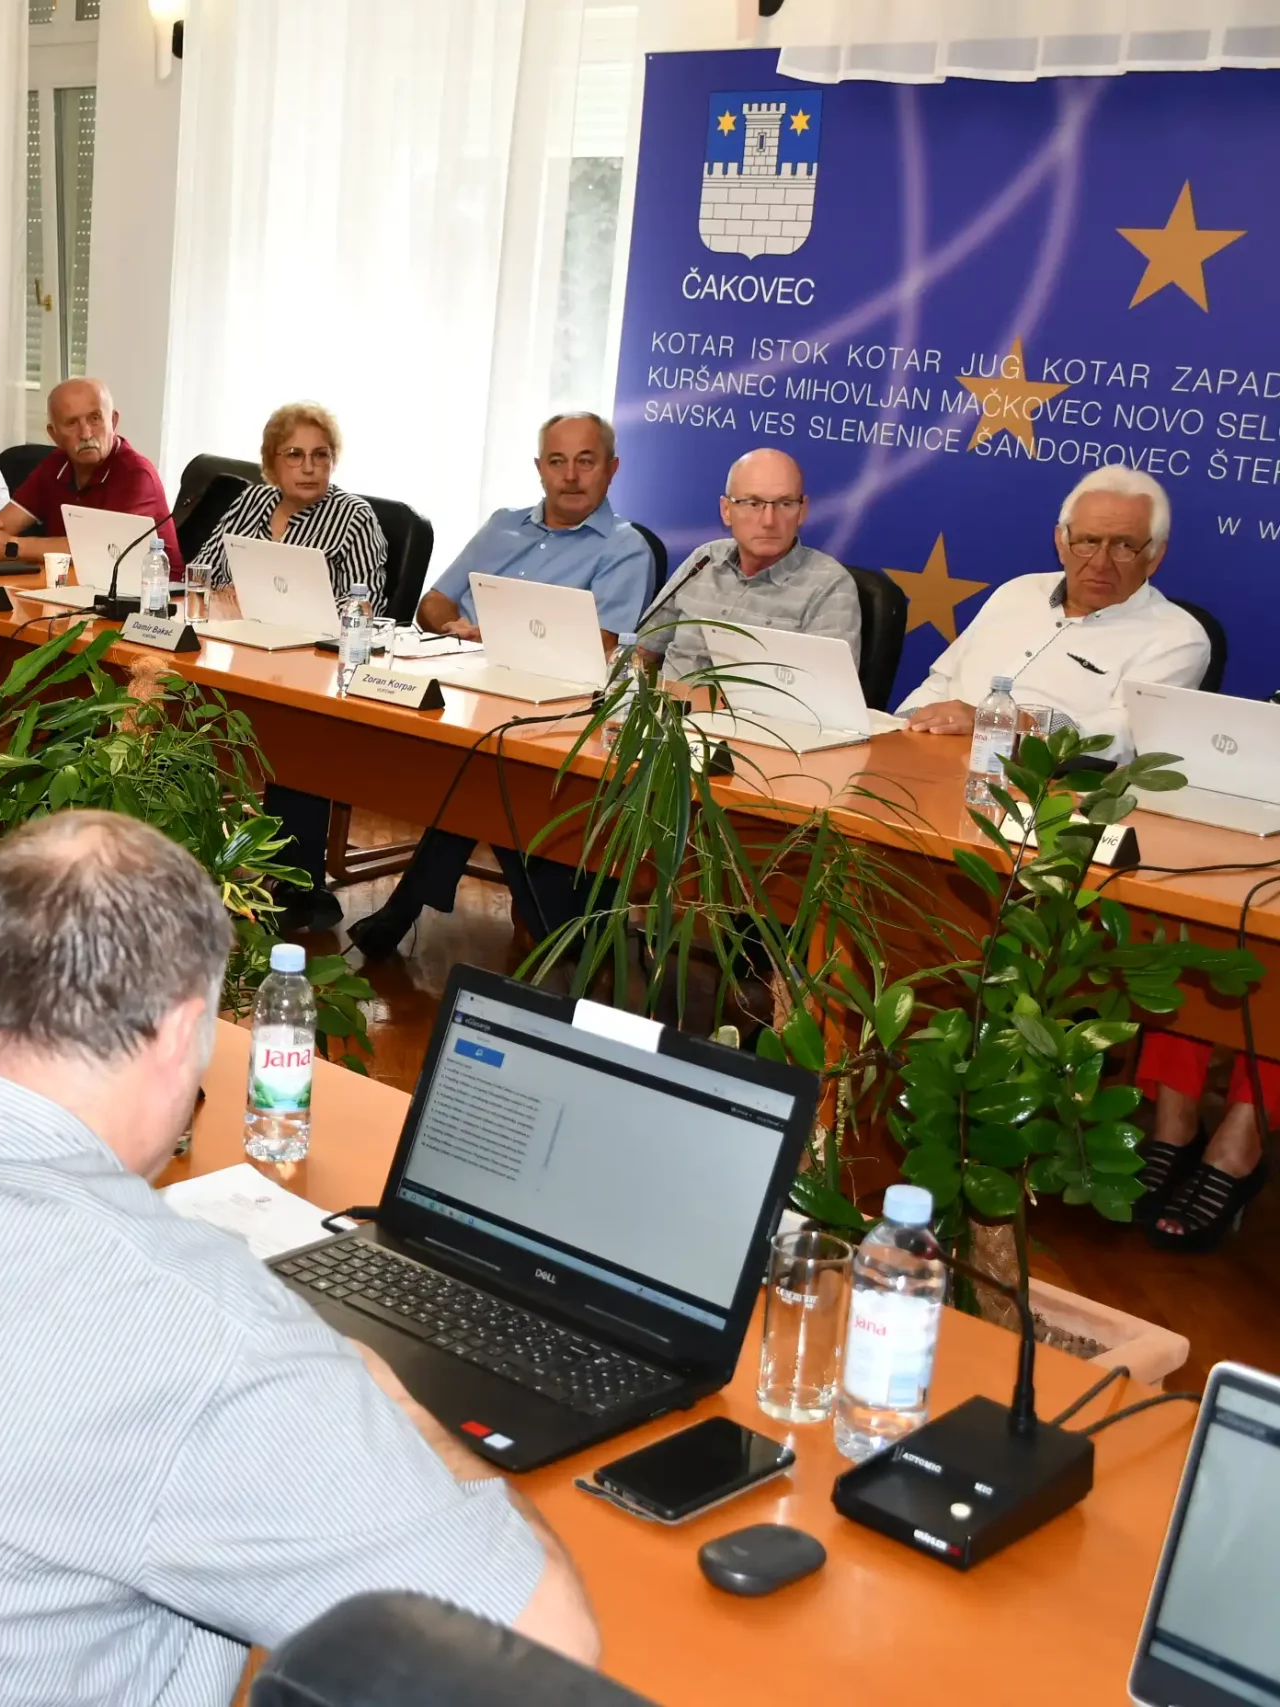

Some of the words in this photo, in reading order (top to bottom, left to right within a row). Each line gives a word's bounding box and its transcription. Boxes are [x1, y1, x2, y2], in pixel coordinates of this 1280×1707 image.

[682, 266, 816, 306] ČAKOVEC
[651, 331, 734, 358] KOTAR
[751, 337, 831, 365] ISTOK
[847, 344, 942, 374] KOTAR
[960, 352, 1021, 380] JUG
[1042, 357, 1151, 389] KOTAR
[1170, 365, 1280, 399] ZAPAD
[647, 365, 776, 398] KURŠANEC
[785, 376, 930, 411] MIHOVLJAN
[940, 388, 1103, 427] MAČKOVEC
[1113, 403, 1204, 435] NOVO
[1216, 411, 1280, 442] SEL
[644, 400, 737, 430] SAVSKA
[749, 409, 796, 436] VES
[808, 415, 962, 453] SLEMENICE
[975, 426, 1191, 476] ŠANDOROVEC
[132, 621, 153, 632] Damir
[362, 673, 387, 686] Zoran
[387, 679, 418, 692] Korpar
[1211, 733, 1239, 755] hp
[261, 1047, 311, 1069] Jana
[535, 1268, 556, 1284] DELL
